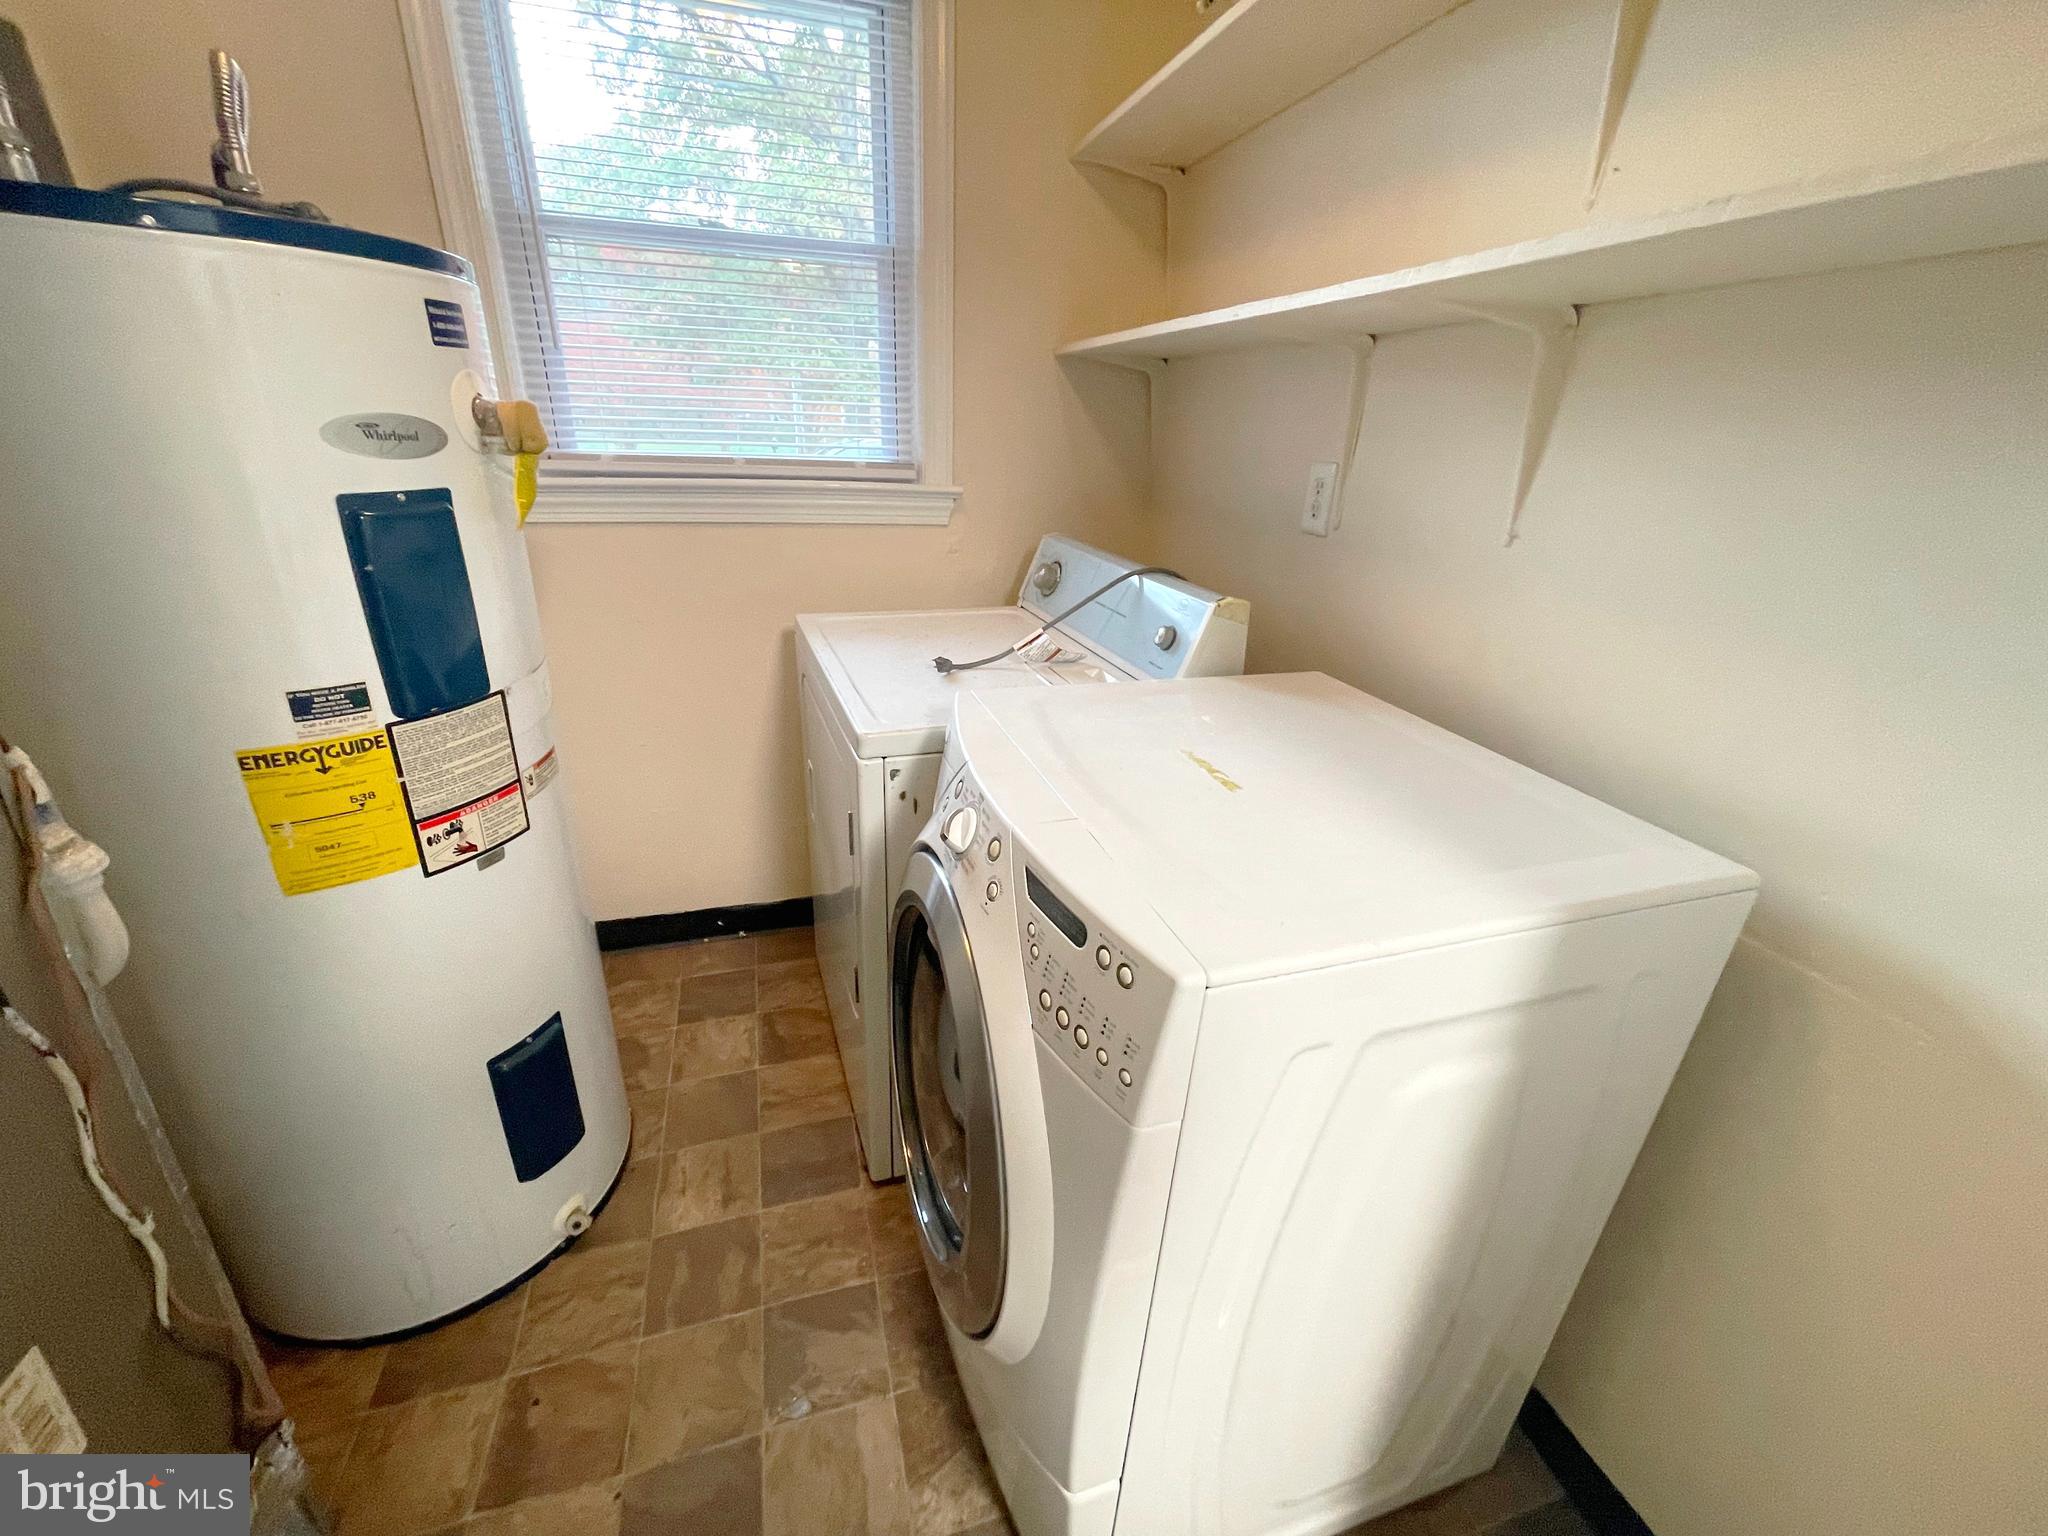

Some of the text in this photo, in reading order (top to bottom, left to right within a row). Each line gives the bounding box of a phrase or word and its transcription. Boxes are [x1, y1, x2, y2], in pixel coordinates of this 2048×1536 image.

[361, 429, 420, 444] Whirlpool
[327, 693, 345, 701] NOT
[237, 734, 388, 773] ENERGYGUIDE
[349, 791, 377, 804] 538
[465, 795, 499, 814] DANGER
